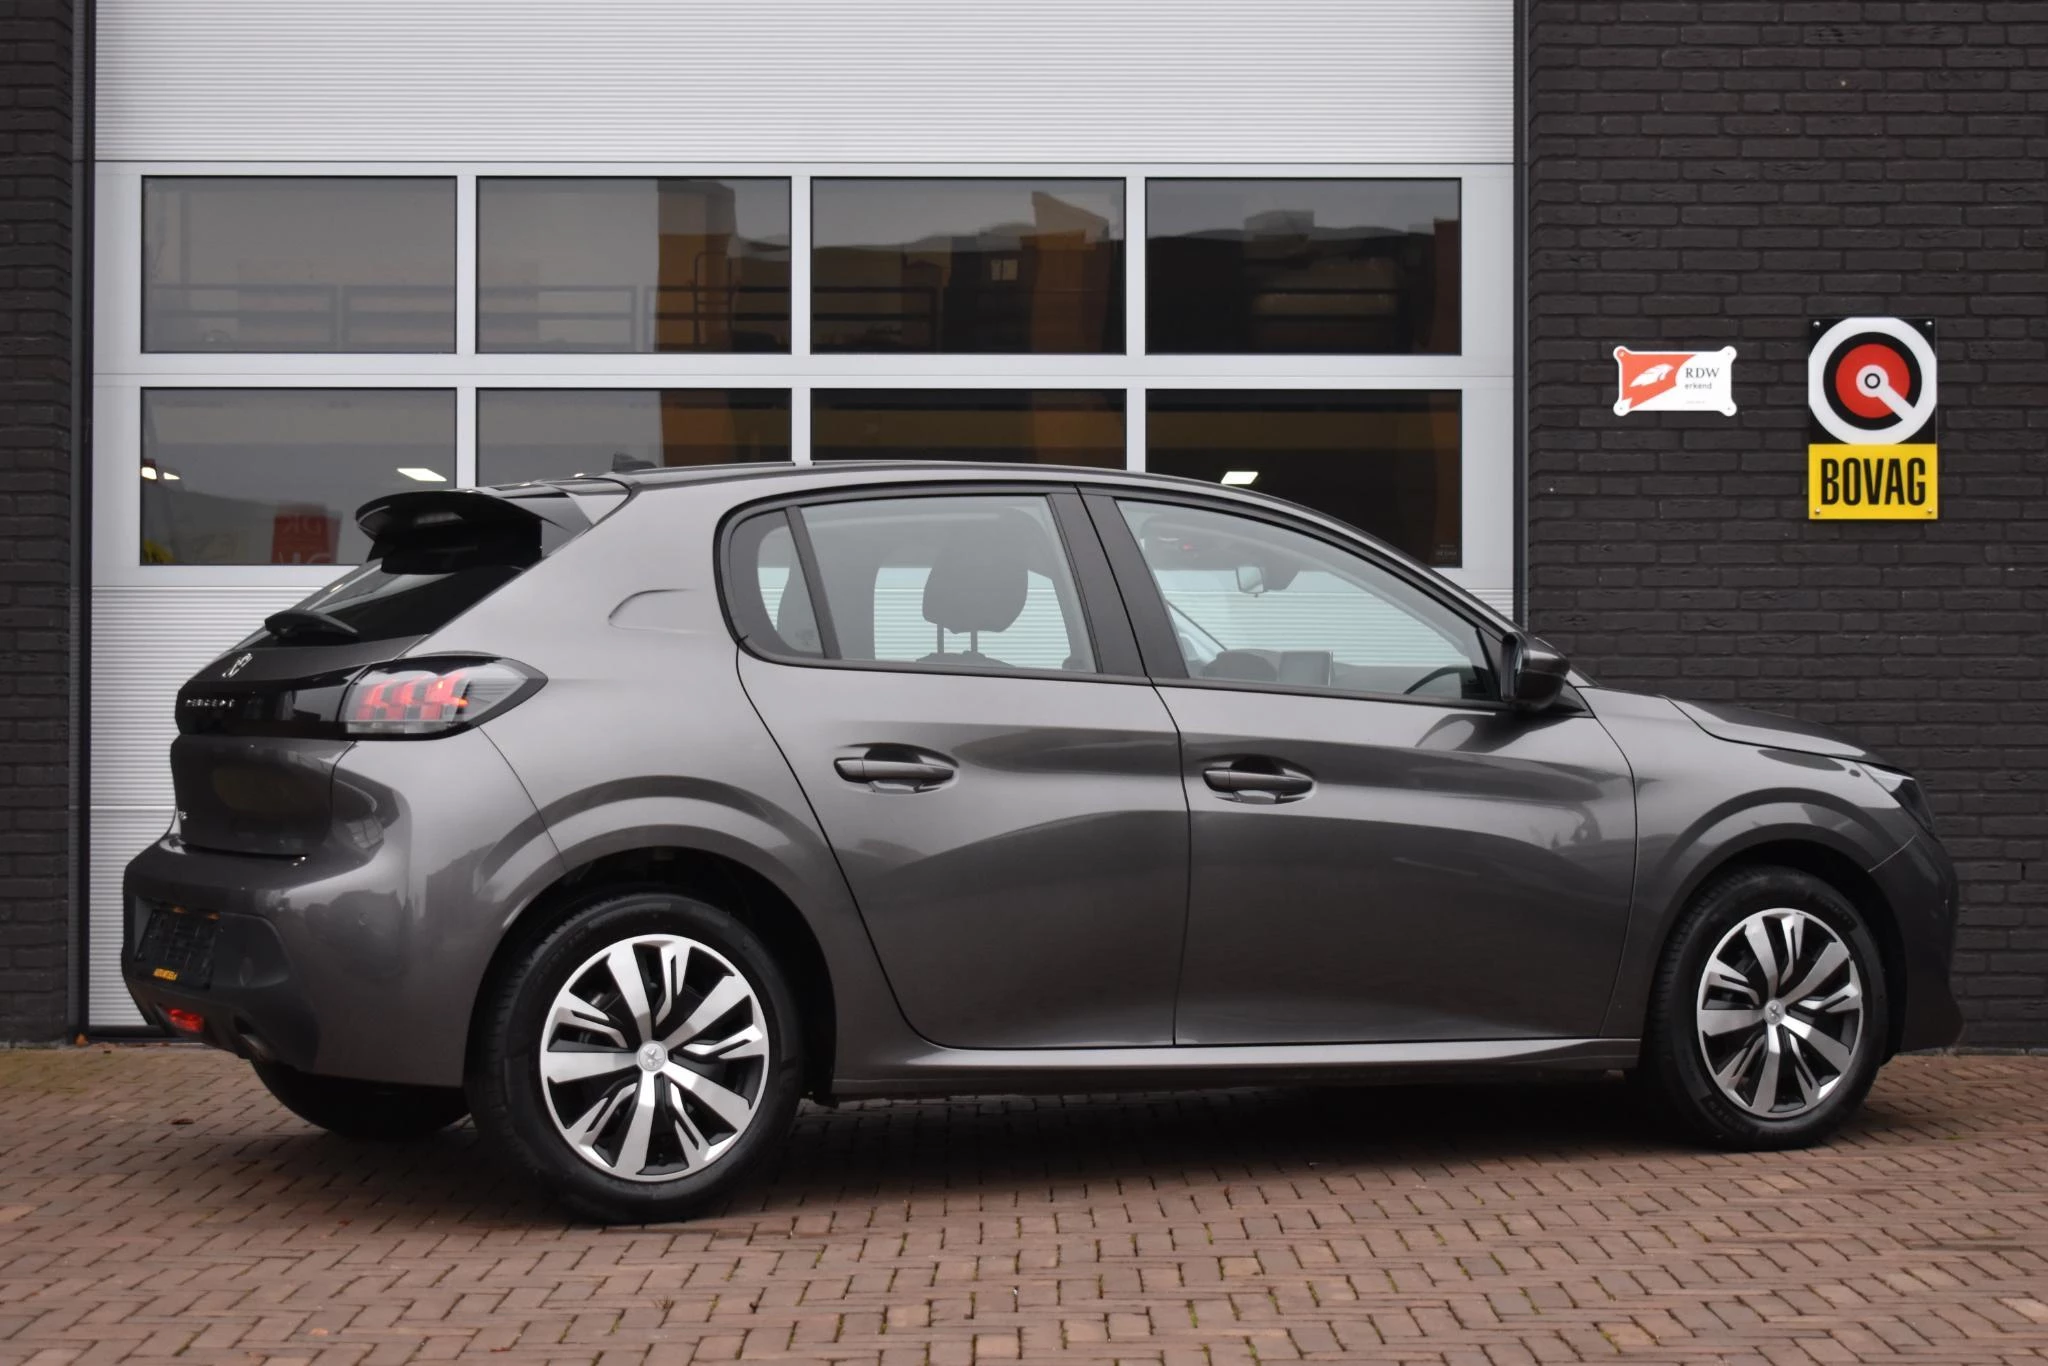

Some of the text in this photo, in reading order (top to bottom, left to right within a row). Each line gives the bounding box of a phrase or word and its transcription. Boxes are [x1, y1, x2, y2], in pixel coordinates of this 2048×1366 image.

[1685, 367, 1720, 379] RDW
[1684, 381, 1713, 390] erkend
[1821, 457, 1926, 506] BOVAG
